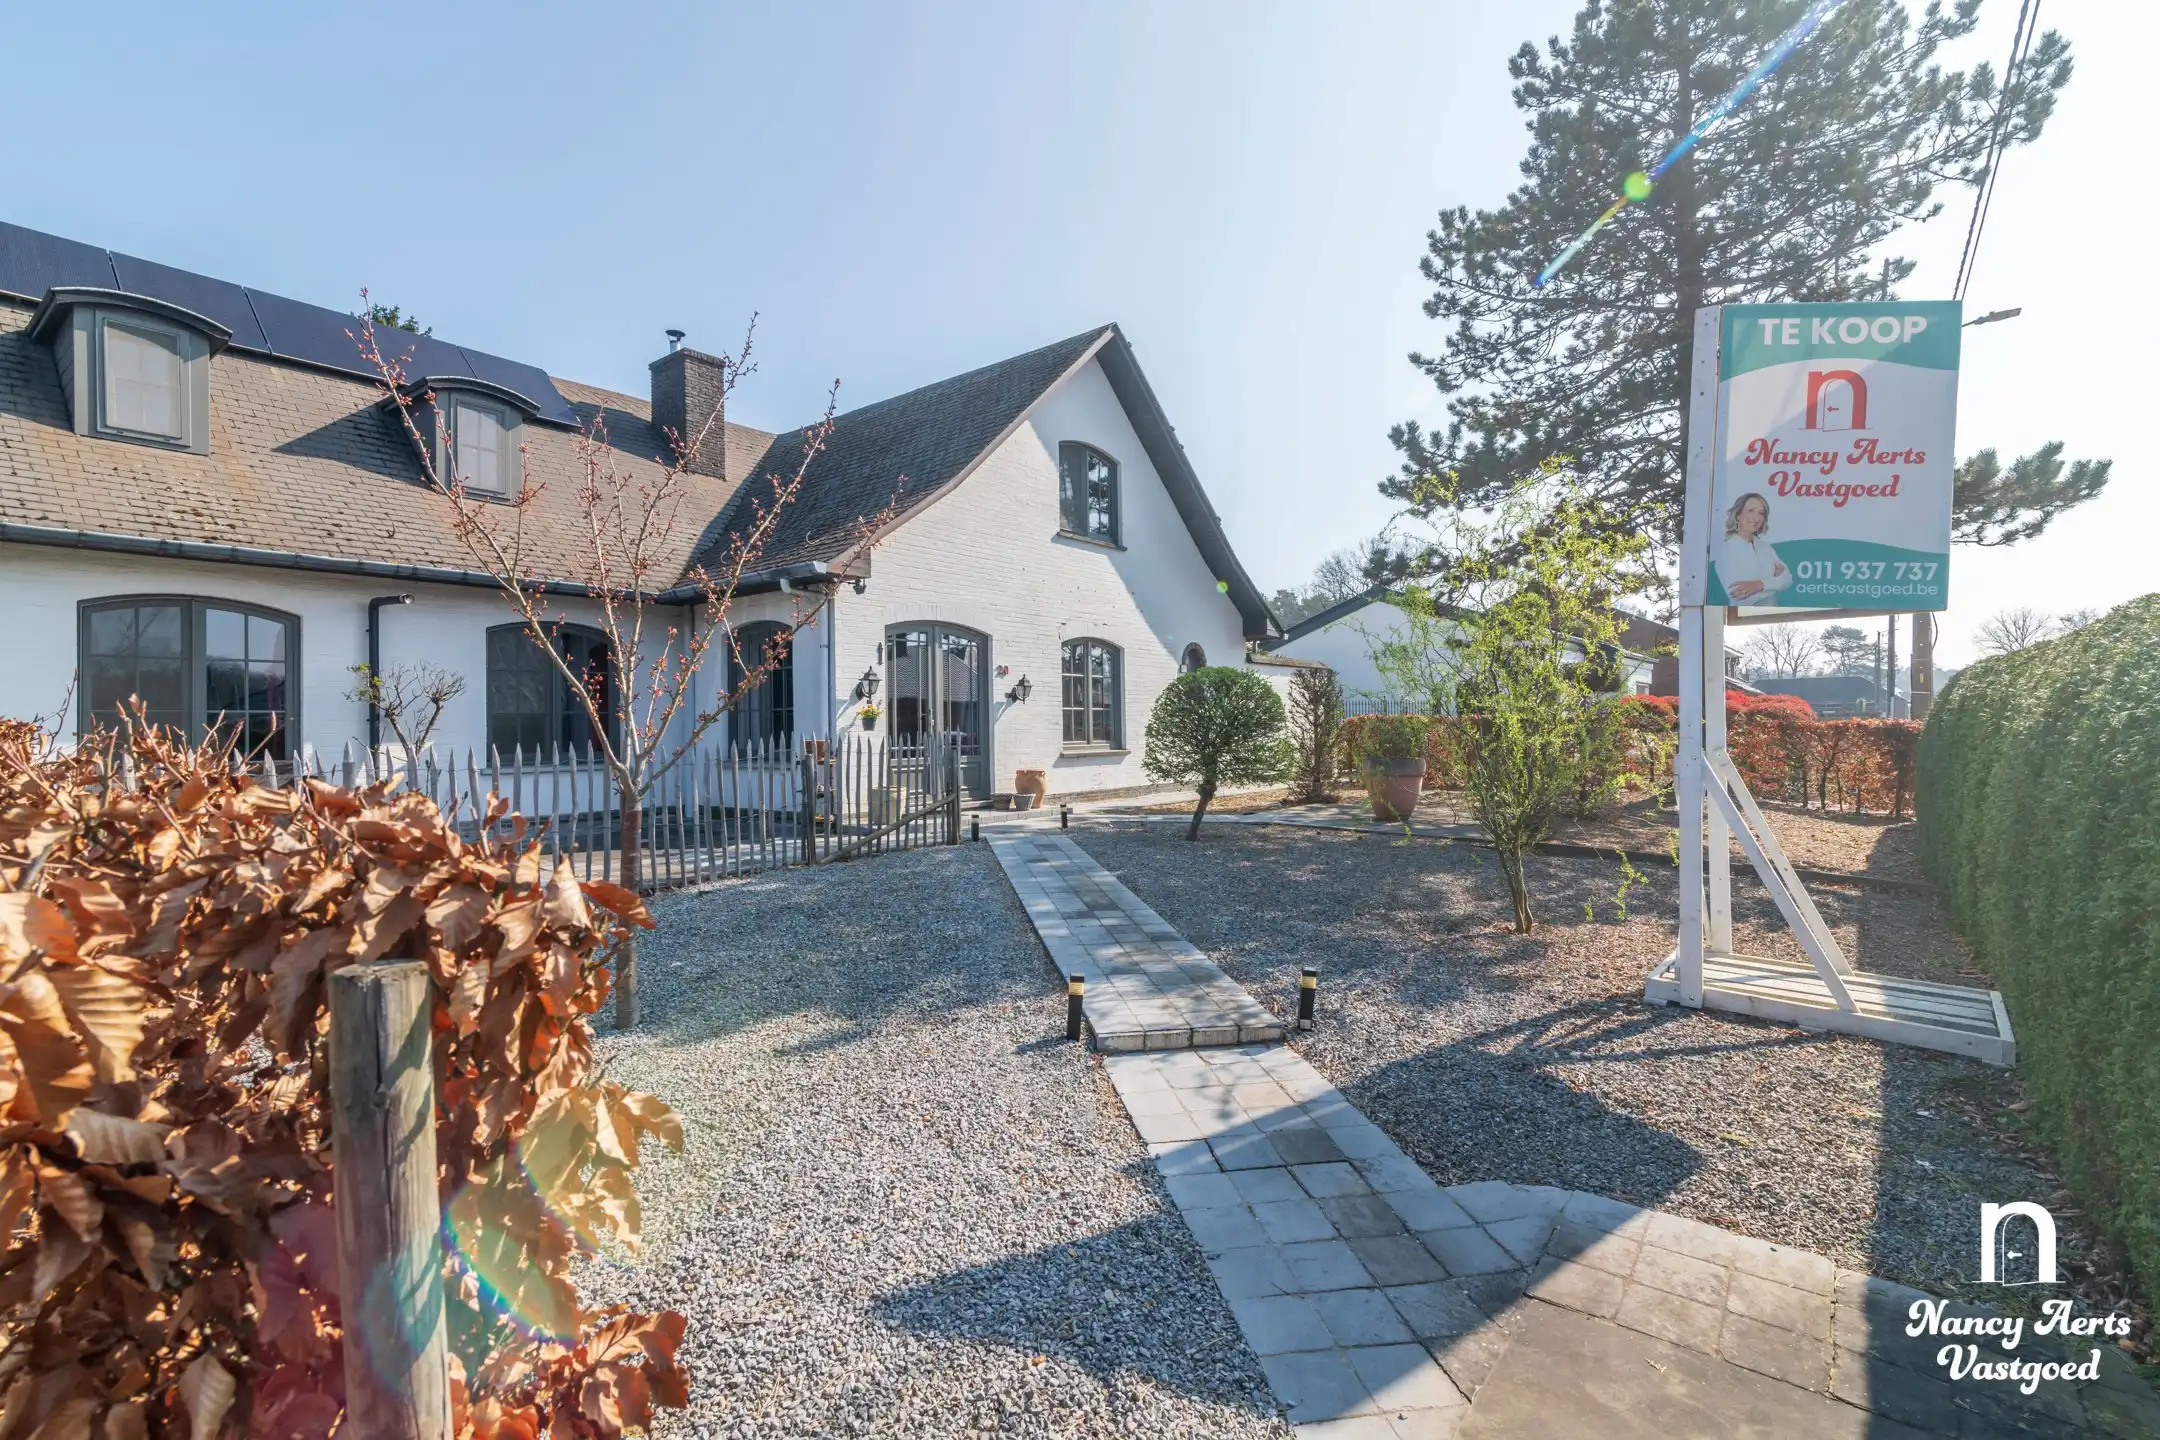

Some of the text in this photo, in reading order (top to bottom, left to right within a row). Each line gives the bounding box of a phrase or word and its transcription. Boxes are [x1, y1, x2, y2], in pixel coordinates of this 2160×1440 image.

[1758, 315, 1928, 345] TE KOOP
[1744, 438, 1927, 475] Nancy Aerts
[1767, 470, 1901, 508] Vastgoed
[1796, 560, 1939, 581] 011 937 737
[1796, 582, 1939, 598] aertsvastgoed.be
